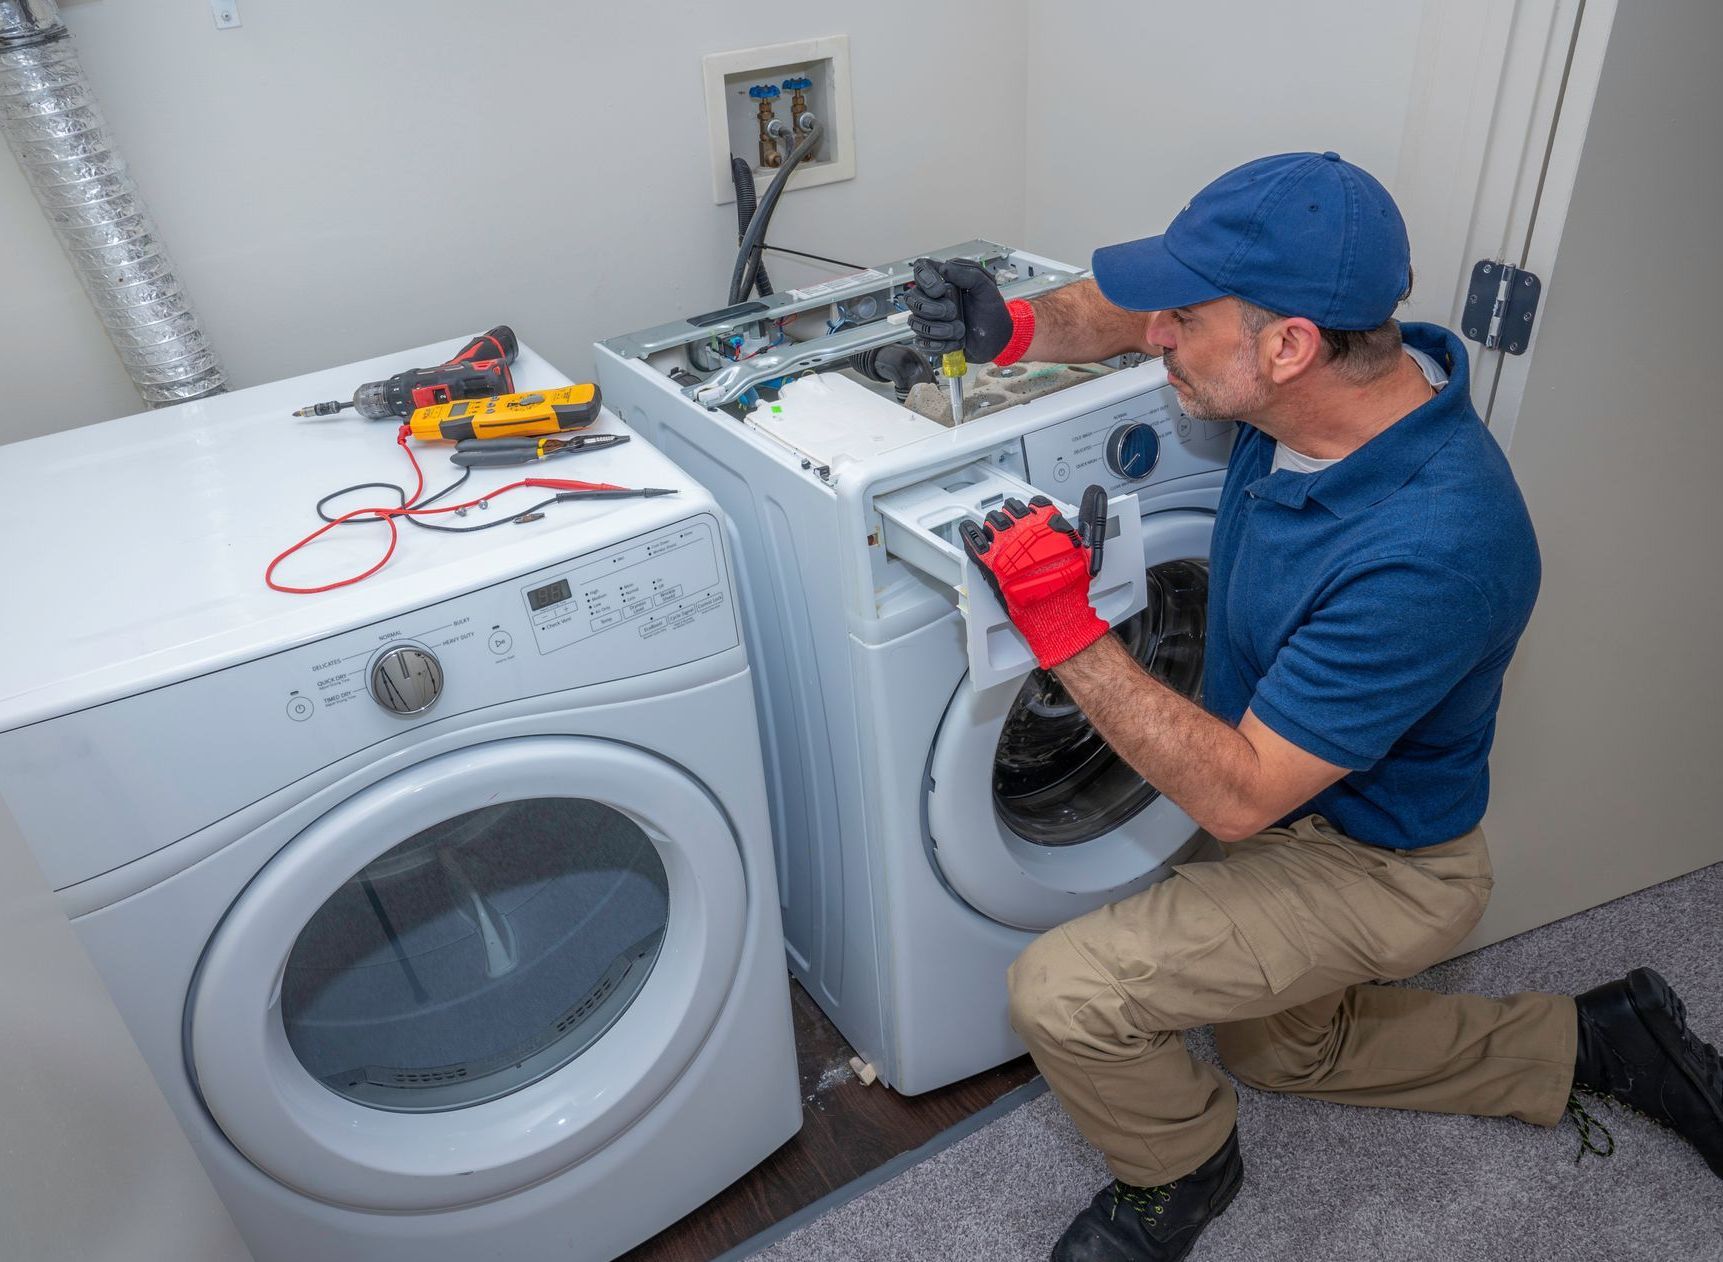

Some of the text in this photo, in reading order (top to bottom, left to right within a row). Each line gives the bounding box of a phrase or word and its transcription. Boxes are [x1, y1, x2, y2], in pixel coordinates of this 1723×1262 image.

[453, 616, 470, 626] BULKY
[546, 620, 560, 630] Check
[379, 630, 402, 641] NORMAL
[442, 632, 475, 646] HEAVY DUTY
[312, 659, 342, 672] DELICATES
[316, 678, 335, 687] QUICK
[335, 673, 347, 681] DRY
[324, 694, 340, 703] TIMED
